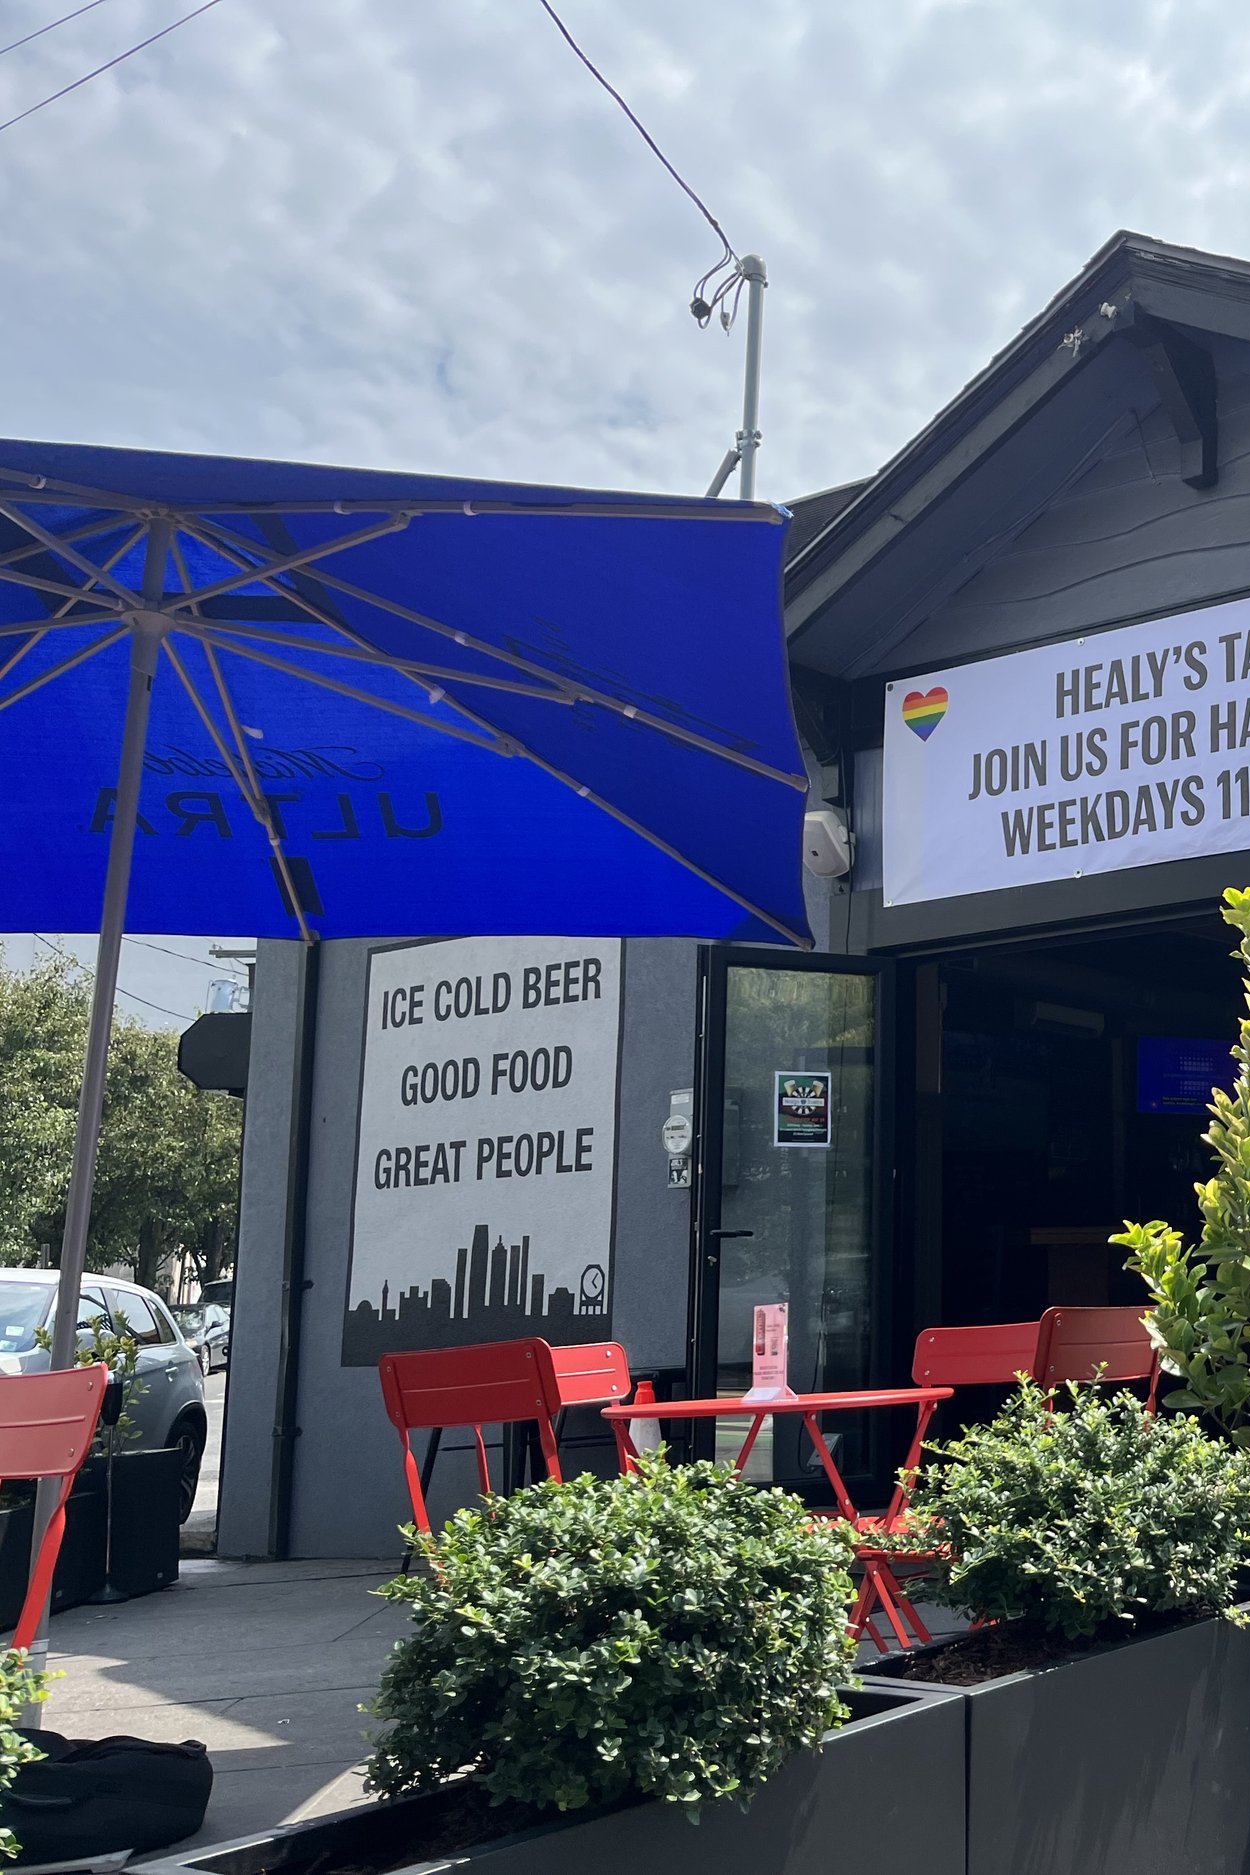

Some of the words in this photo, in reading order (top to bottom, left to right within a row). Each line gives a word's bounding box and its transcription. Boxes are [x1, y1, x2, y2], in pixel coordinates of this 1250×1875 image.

[1055, 639, 1208, 719] HEALY'S
[968, 741, 1048, 800] JOIN
[1060, 727, 1109, 782] US
[1119, 710, 1197, 770] FOR
[1000, 775, 1206, 858] WEEKDAYS
[381, 985, 424, 1030] ICE
[434, 972, 512, 1022] COLD
[522, 957, 602, 1010] BEER
[401, 1056, 480, 1106] GOOD
[490, 1045, 573, 1096] FOOD
[374, 1140, 466, 1190] GREAT
[476, 1127, 594, 1180] PEOPLE
